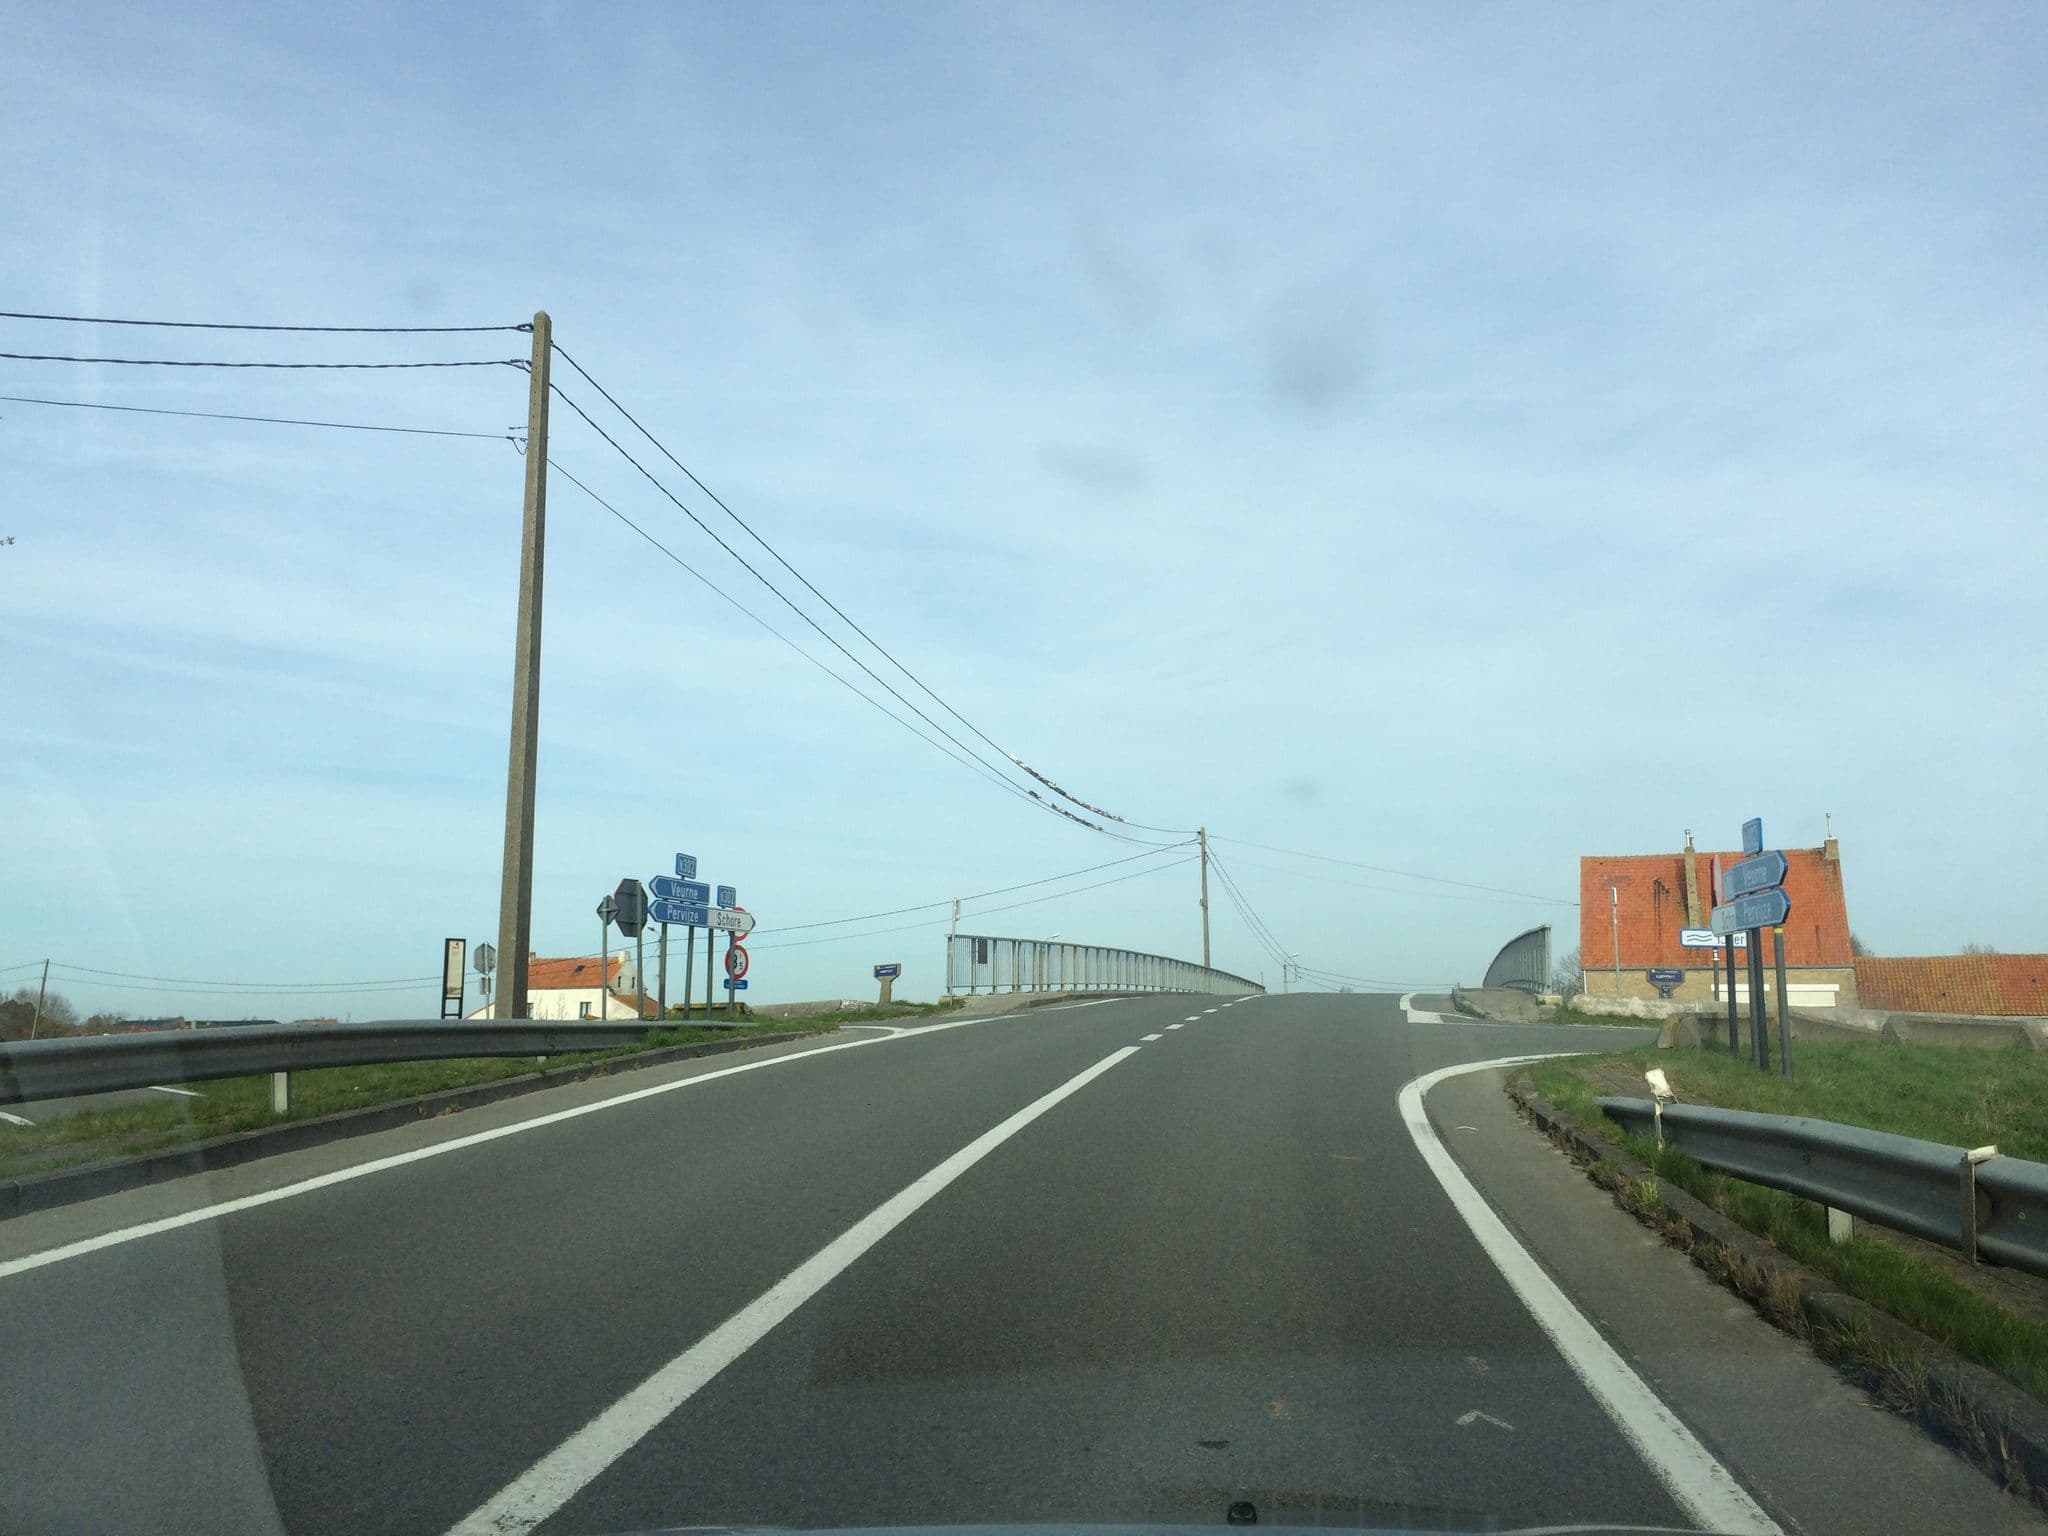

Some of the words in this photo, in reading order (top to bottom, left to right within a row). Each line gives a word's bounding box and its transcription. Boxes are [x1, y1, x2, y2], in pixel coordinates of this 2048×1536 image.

[671, 882, 698, 899] Veurne
[667, 905, 699, 924] Pervijze
[717, 912, 741, 927] Schore
